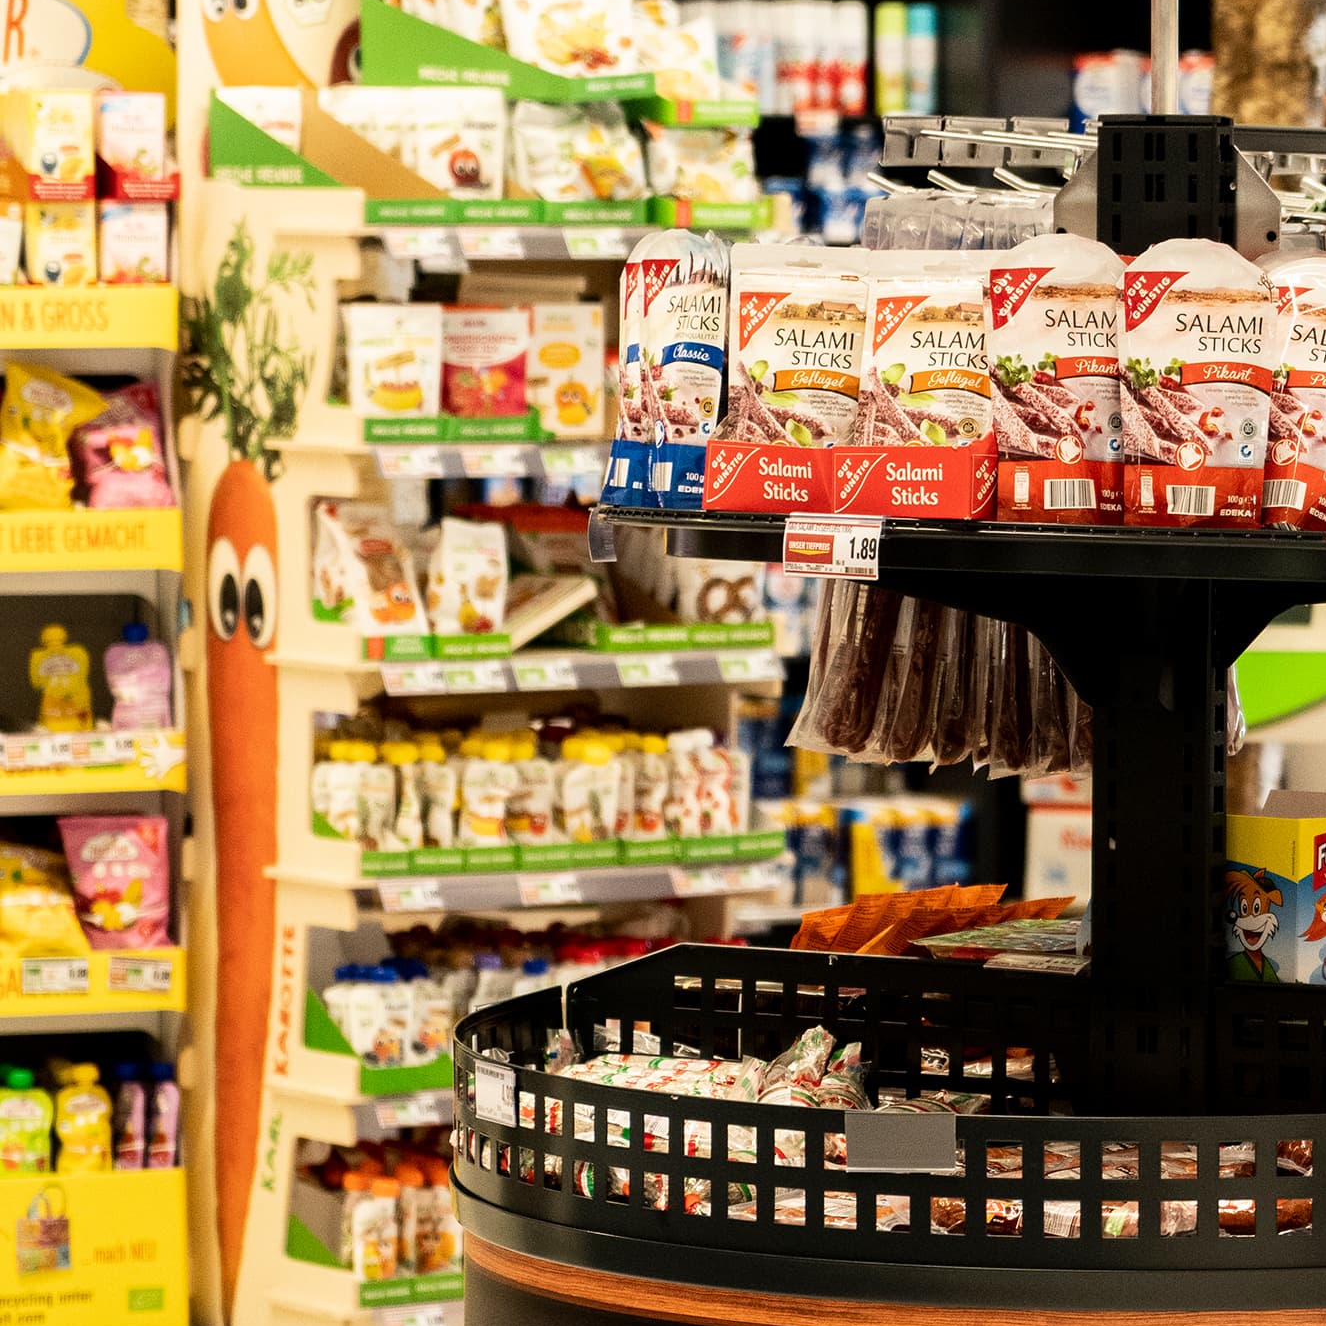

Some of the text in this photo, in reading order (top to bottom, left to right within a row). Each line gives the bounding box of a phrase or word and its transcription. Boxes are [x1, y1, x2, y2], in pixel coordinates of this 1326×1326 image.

[992, 272, 1013, 293] GUT
[1127, 276, 1147, 298] GUT
[667, 295, 721, 315] SALAMI
[740, 296, 760, 316] GUT
[877, 301, 895, 323] GUT
[22, 302, 36, 327] &
[41, 301, 108, 332] GROSS
[676, 315, 720, 333] STICKS
[1175, 313, 1263, 335] SALAMI
[774, 328, 855, 351] SALAMI
[1198, 336, 1262, 354] STICKS
[672, 343, 711, 363] Classic
[791, 350, 853, 370] STICKS
[928, 352, 989, 370] STICKS
[1074, 359, 1119, 375] Pikant
[1203, 364, 1255, 382] Pikant
[790, 370, 845, 389] Geflügel
[928, 371, 983, 389] Geflügel
[711, 449, 728, 469] GUT
[758, 457, 812, 479] Salami
[837, 458, 853, 478] GUT
[975, 459, 990, 479] GUT
[885, 462, 943, 482] Salami
[763, 481, 809, 502] Sticks
[891, 486, 939, 506] Sticks
[1220, 508, 1252, 518] EDEKA
[11, 525, 57, 554] LIEBE
[849, 537, 877, 561] 1.89
[262, 1111, 283, 1192] KARL
